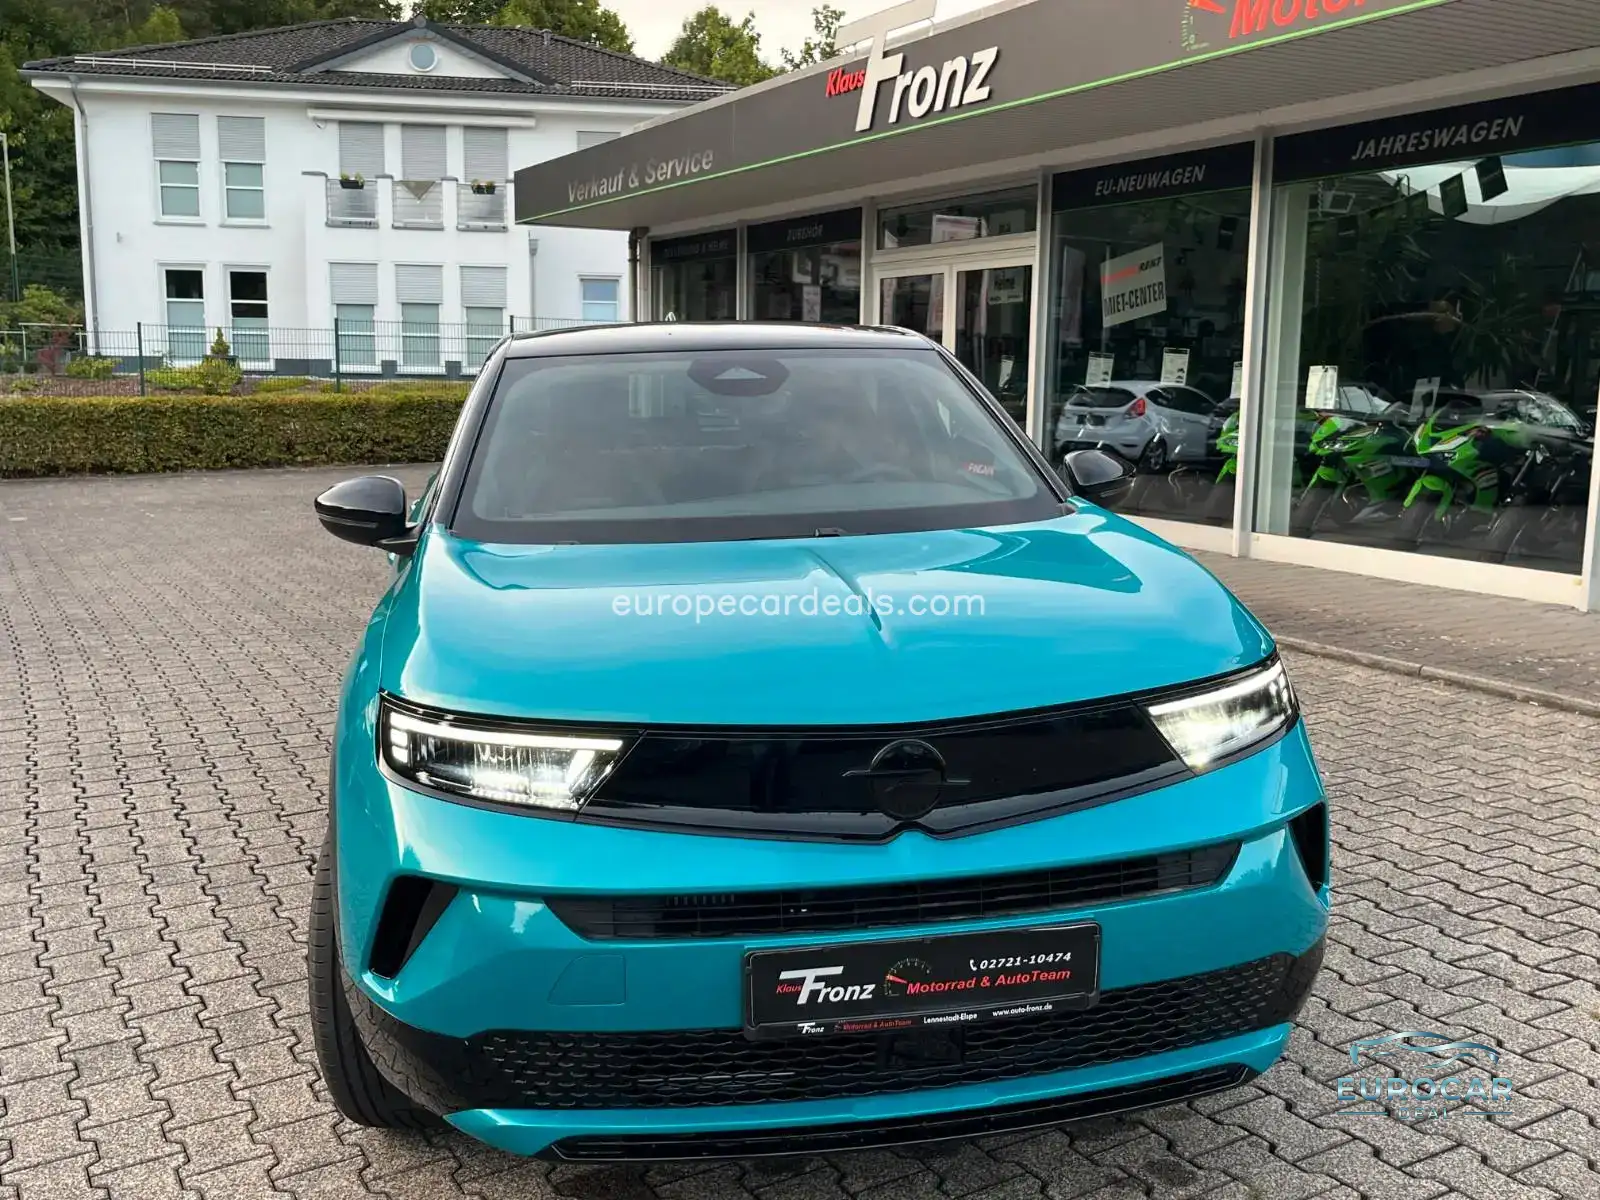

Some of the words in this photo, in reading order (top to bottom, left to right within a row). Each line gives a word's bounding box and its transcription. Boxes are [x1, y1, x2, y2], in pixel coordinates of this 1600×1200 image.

[834, 0, 998, 132] Fronz
[825, 67, 866, 98] Klaus
[1352, 115, 1524, 160] JAHRESWAGEN
[567, 166, 625, 203] Verkauf
[628, 163, 640, 189] &
[645, 149, 714, 184] Service
[1095, 164, 1206, 196] EU-NEUWAGEN
[1103, 281, 1165, 318] MIET-CENTER
[979, 952, 1072, 970] 02721-10474
[779, 965, 876, 1005] Fronz
[906, 977, 976, 995] Motorrad
[980, 978, 991, 988] &
[994, 969, 1071, 987] AutoTeam
[992, 1003, 1053, 1017] www.auto-fronz.de
[797, 1021, 824, 1034] Fronz
